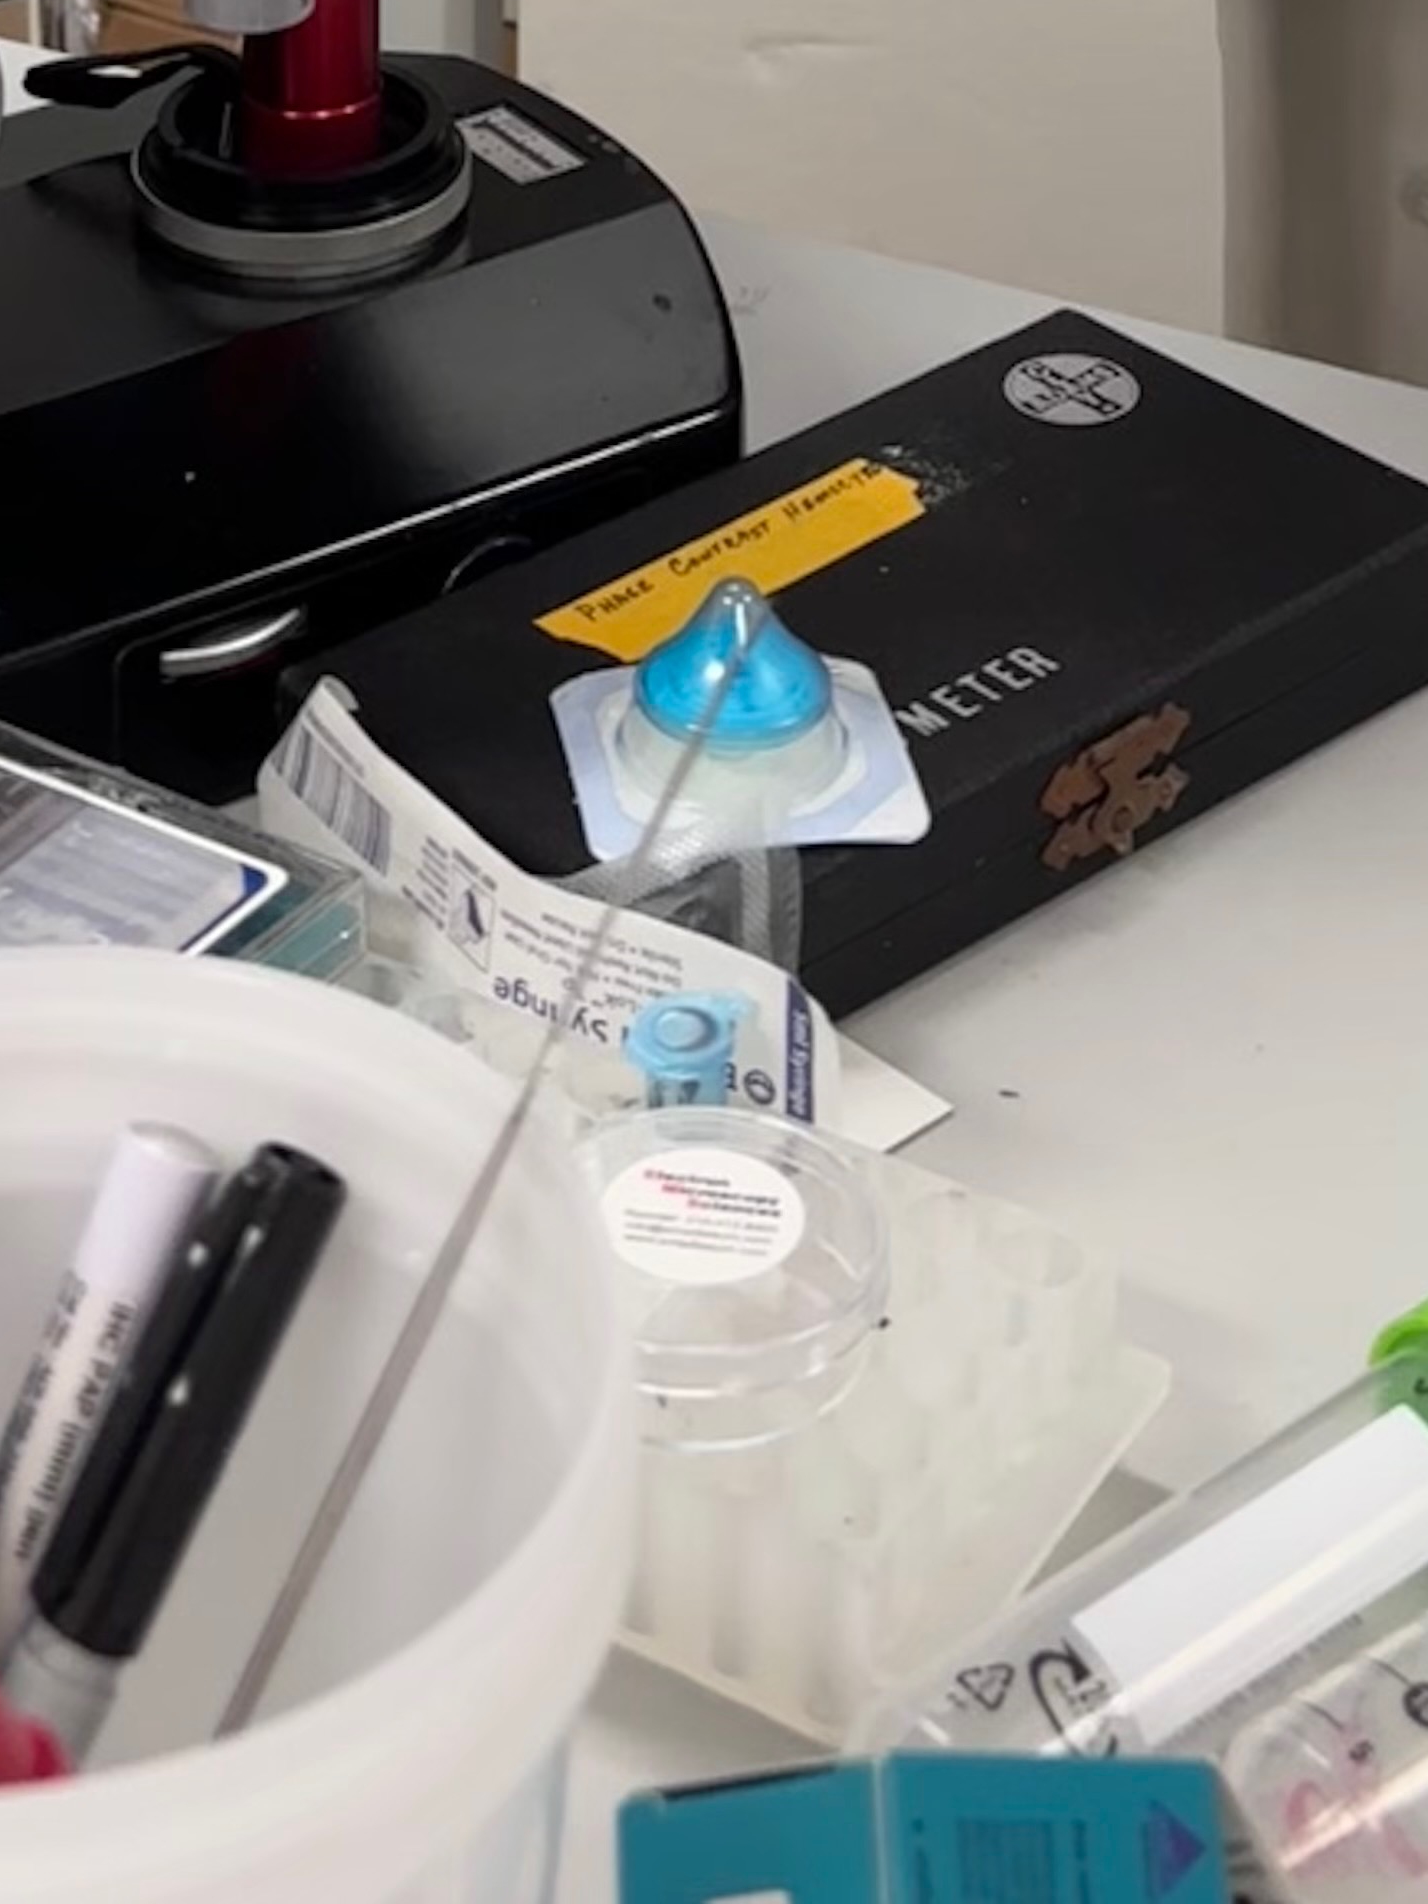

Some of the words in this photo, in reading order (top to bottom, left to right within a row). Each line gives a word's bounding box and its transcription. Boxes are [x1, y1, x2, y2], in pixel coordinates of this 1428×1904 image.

[574, 578, 656, 623] PHASE
[667, 519, 771, 578] CONTRAST
[93, 1299, 135, 1357] IHC
[70, 1355, 114, 1420] PAP
[1348, 1740, 1375, 1767] 5
